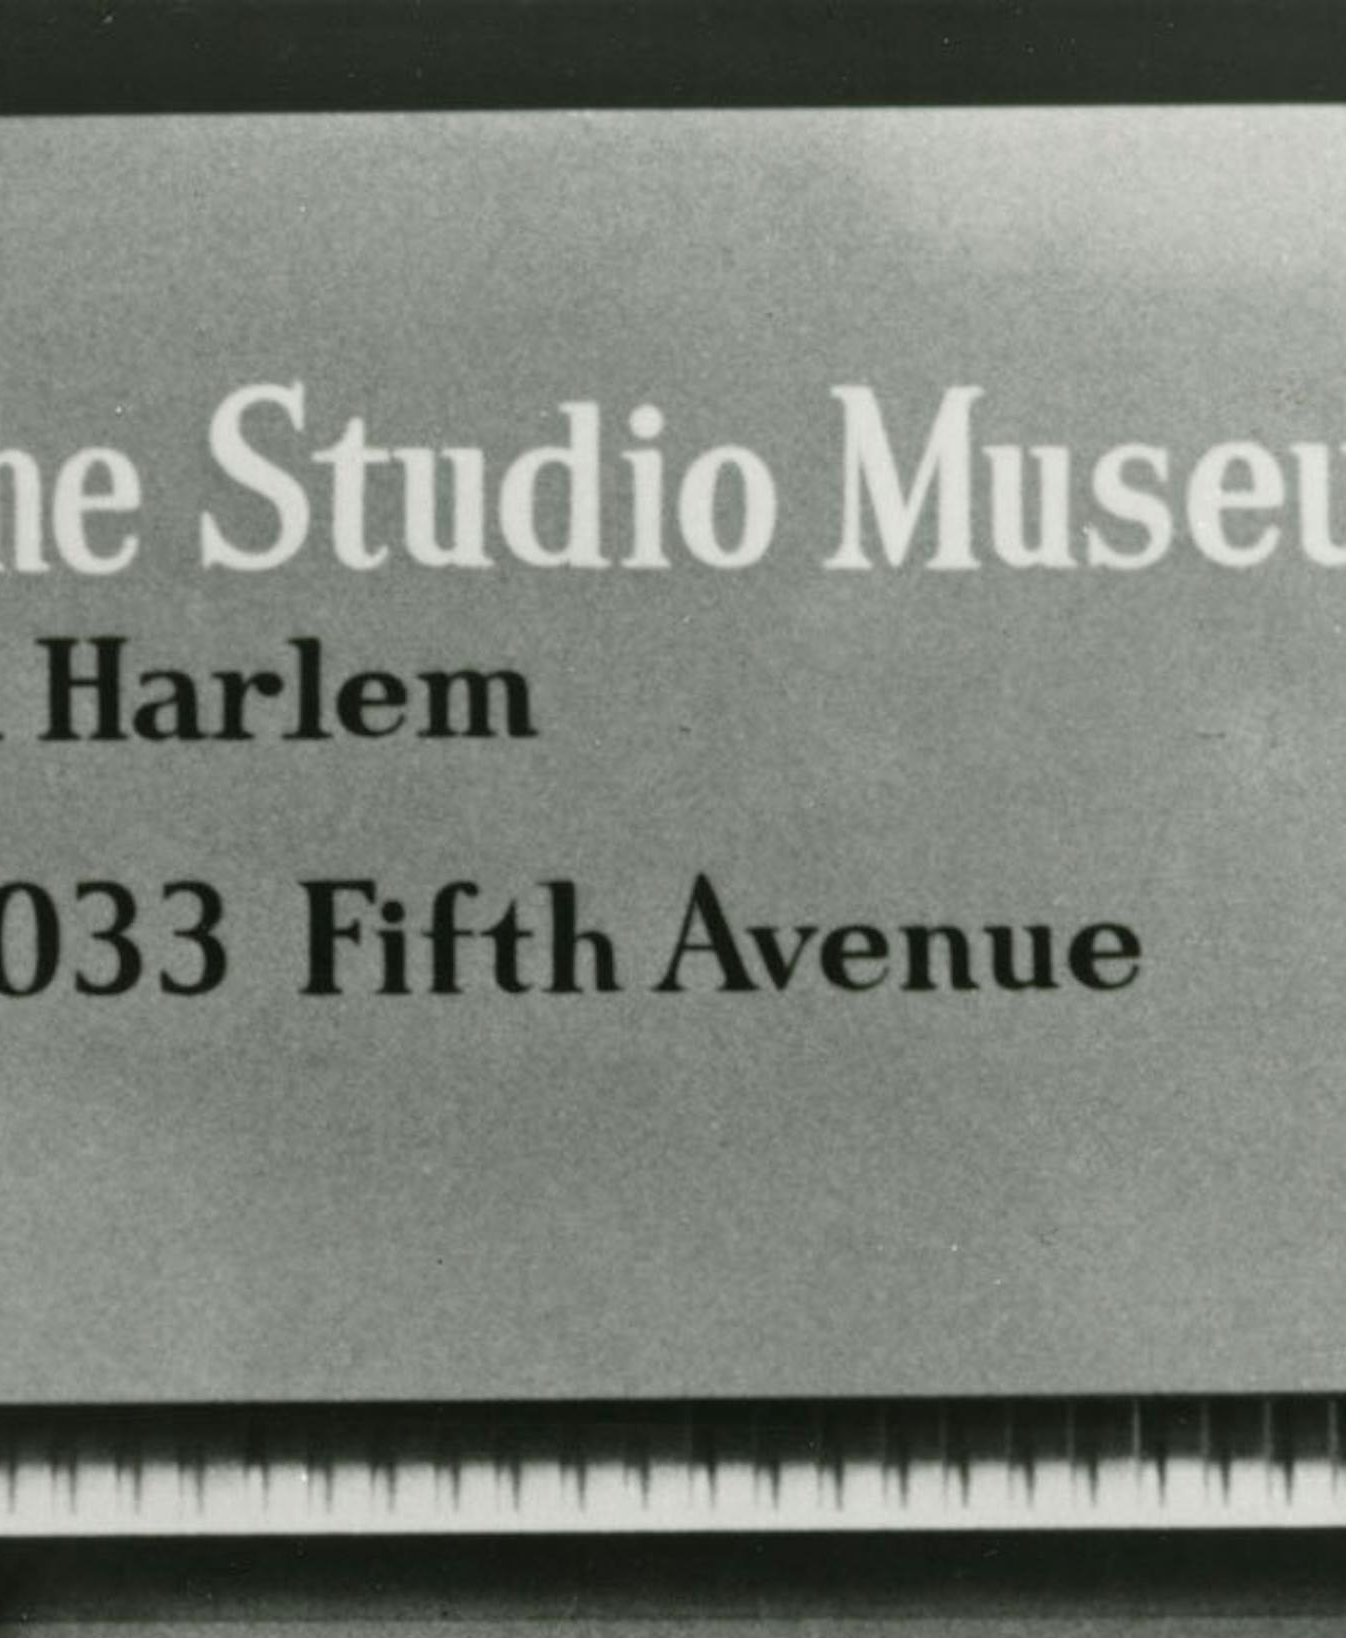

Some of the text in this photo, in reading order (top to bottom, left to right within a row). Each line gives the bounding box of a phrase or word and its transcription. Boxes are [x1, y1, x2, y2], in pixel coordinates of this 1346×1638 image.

[201, 379, 778, 572] Studio
[35, 637, 540, 742] Harlem
[297, 878, 625, 996] Fifth
[650, 873, 1143, 994] Avenue
